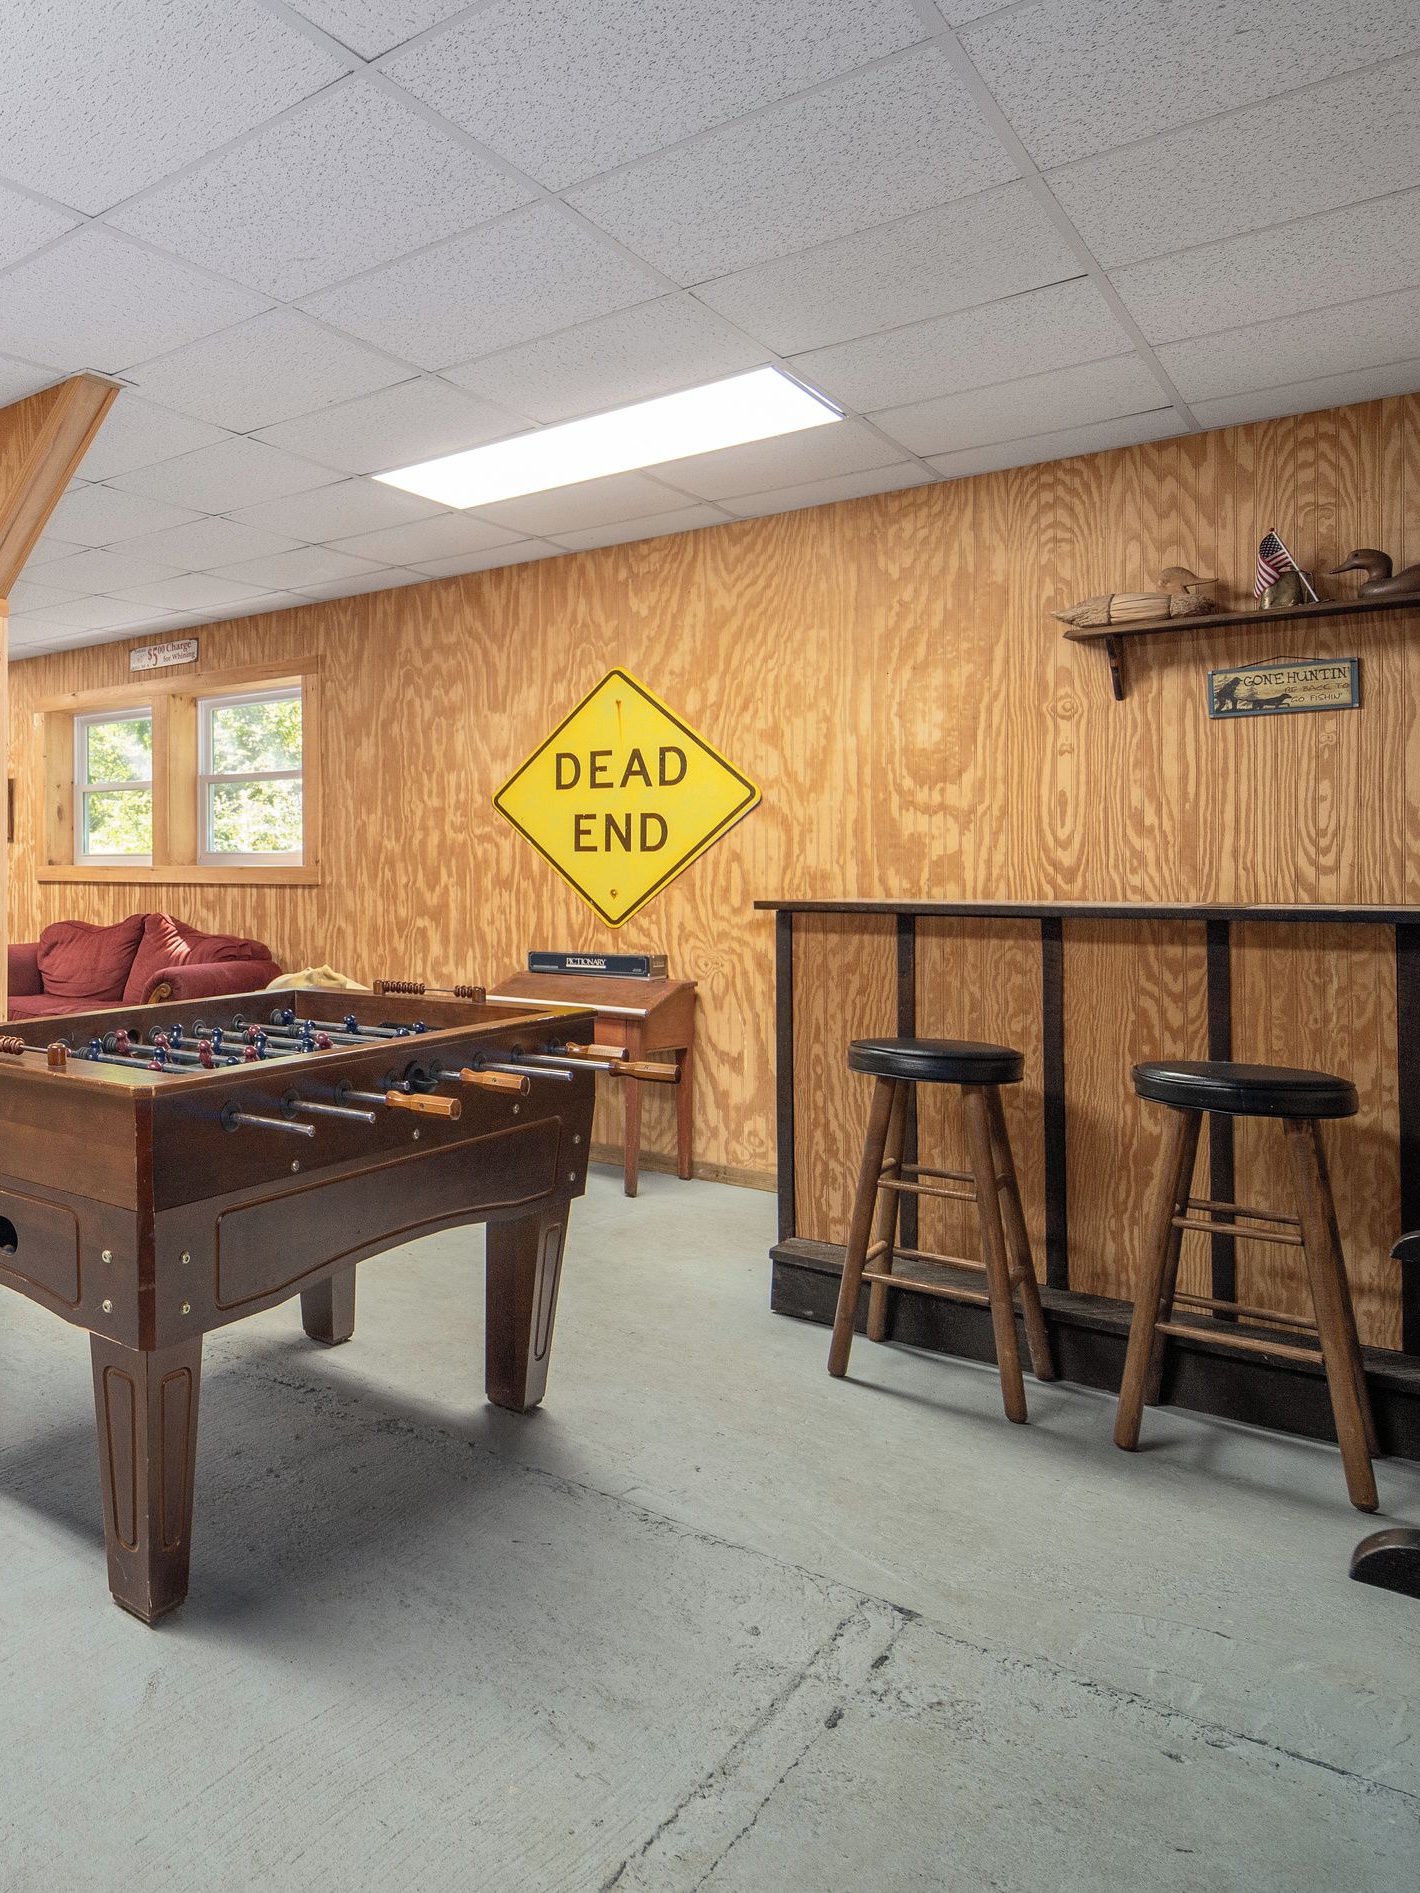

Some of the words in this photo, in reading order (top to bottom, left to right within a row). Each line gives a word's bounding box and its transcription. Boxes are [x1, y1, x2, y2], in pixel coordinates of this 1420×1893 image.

[166, 641, 192, 653] Charge
[172, 651, 196, 660] Whining
[1243, 672, 1284, 687] GONE
[1287, 666, 1350, 684] HUNTIN'
[1302, 684, 1330, 692] BACK
[1336, 682, 1350, 690] TO
[1310, 692, 1343, 702] FISHIN'
[556, 746, 687, 790] DEAD
[574, 813, 668, 852] END
[566, 957, 606, 966] PICTIONARY
